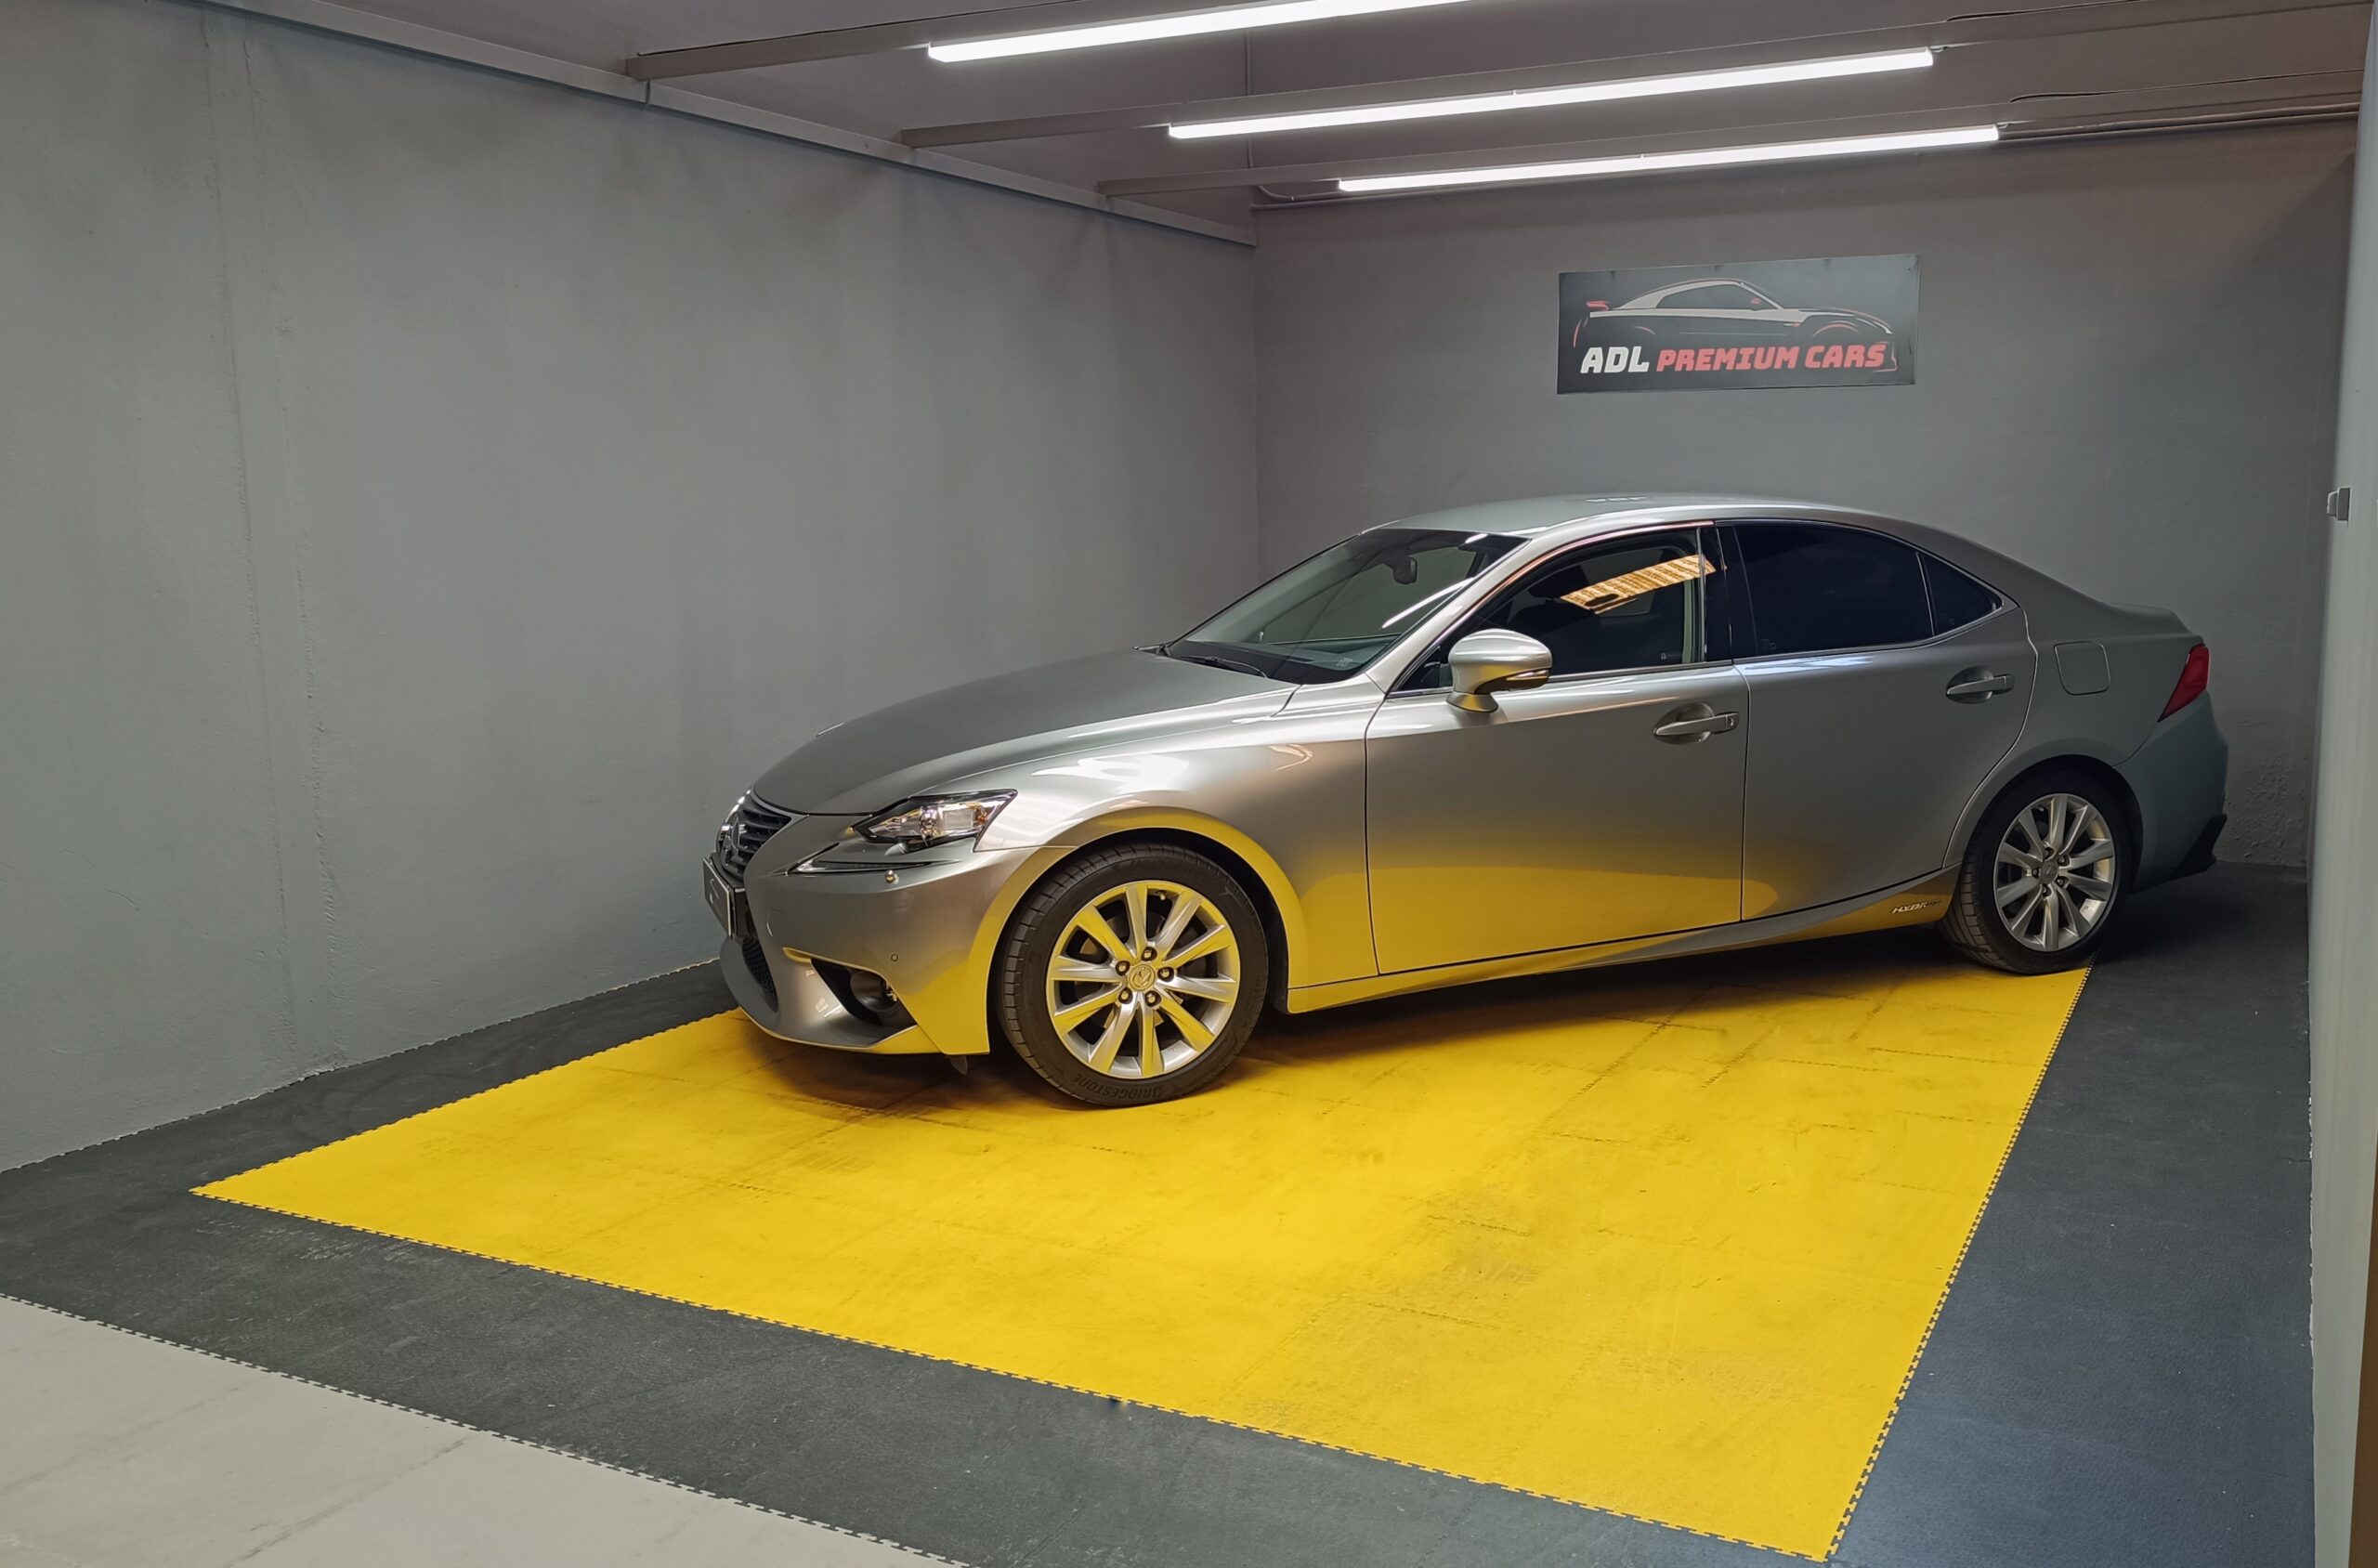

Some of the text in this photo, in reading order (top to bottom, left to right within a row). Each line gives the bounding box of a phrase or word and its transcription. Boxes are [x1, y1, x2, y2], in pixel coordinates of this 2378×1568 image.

[1580, 344, 1887, 373] ADL PREMIUM CARS
[1071, 1075, 1166, 1099] BRIDGESTONE
